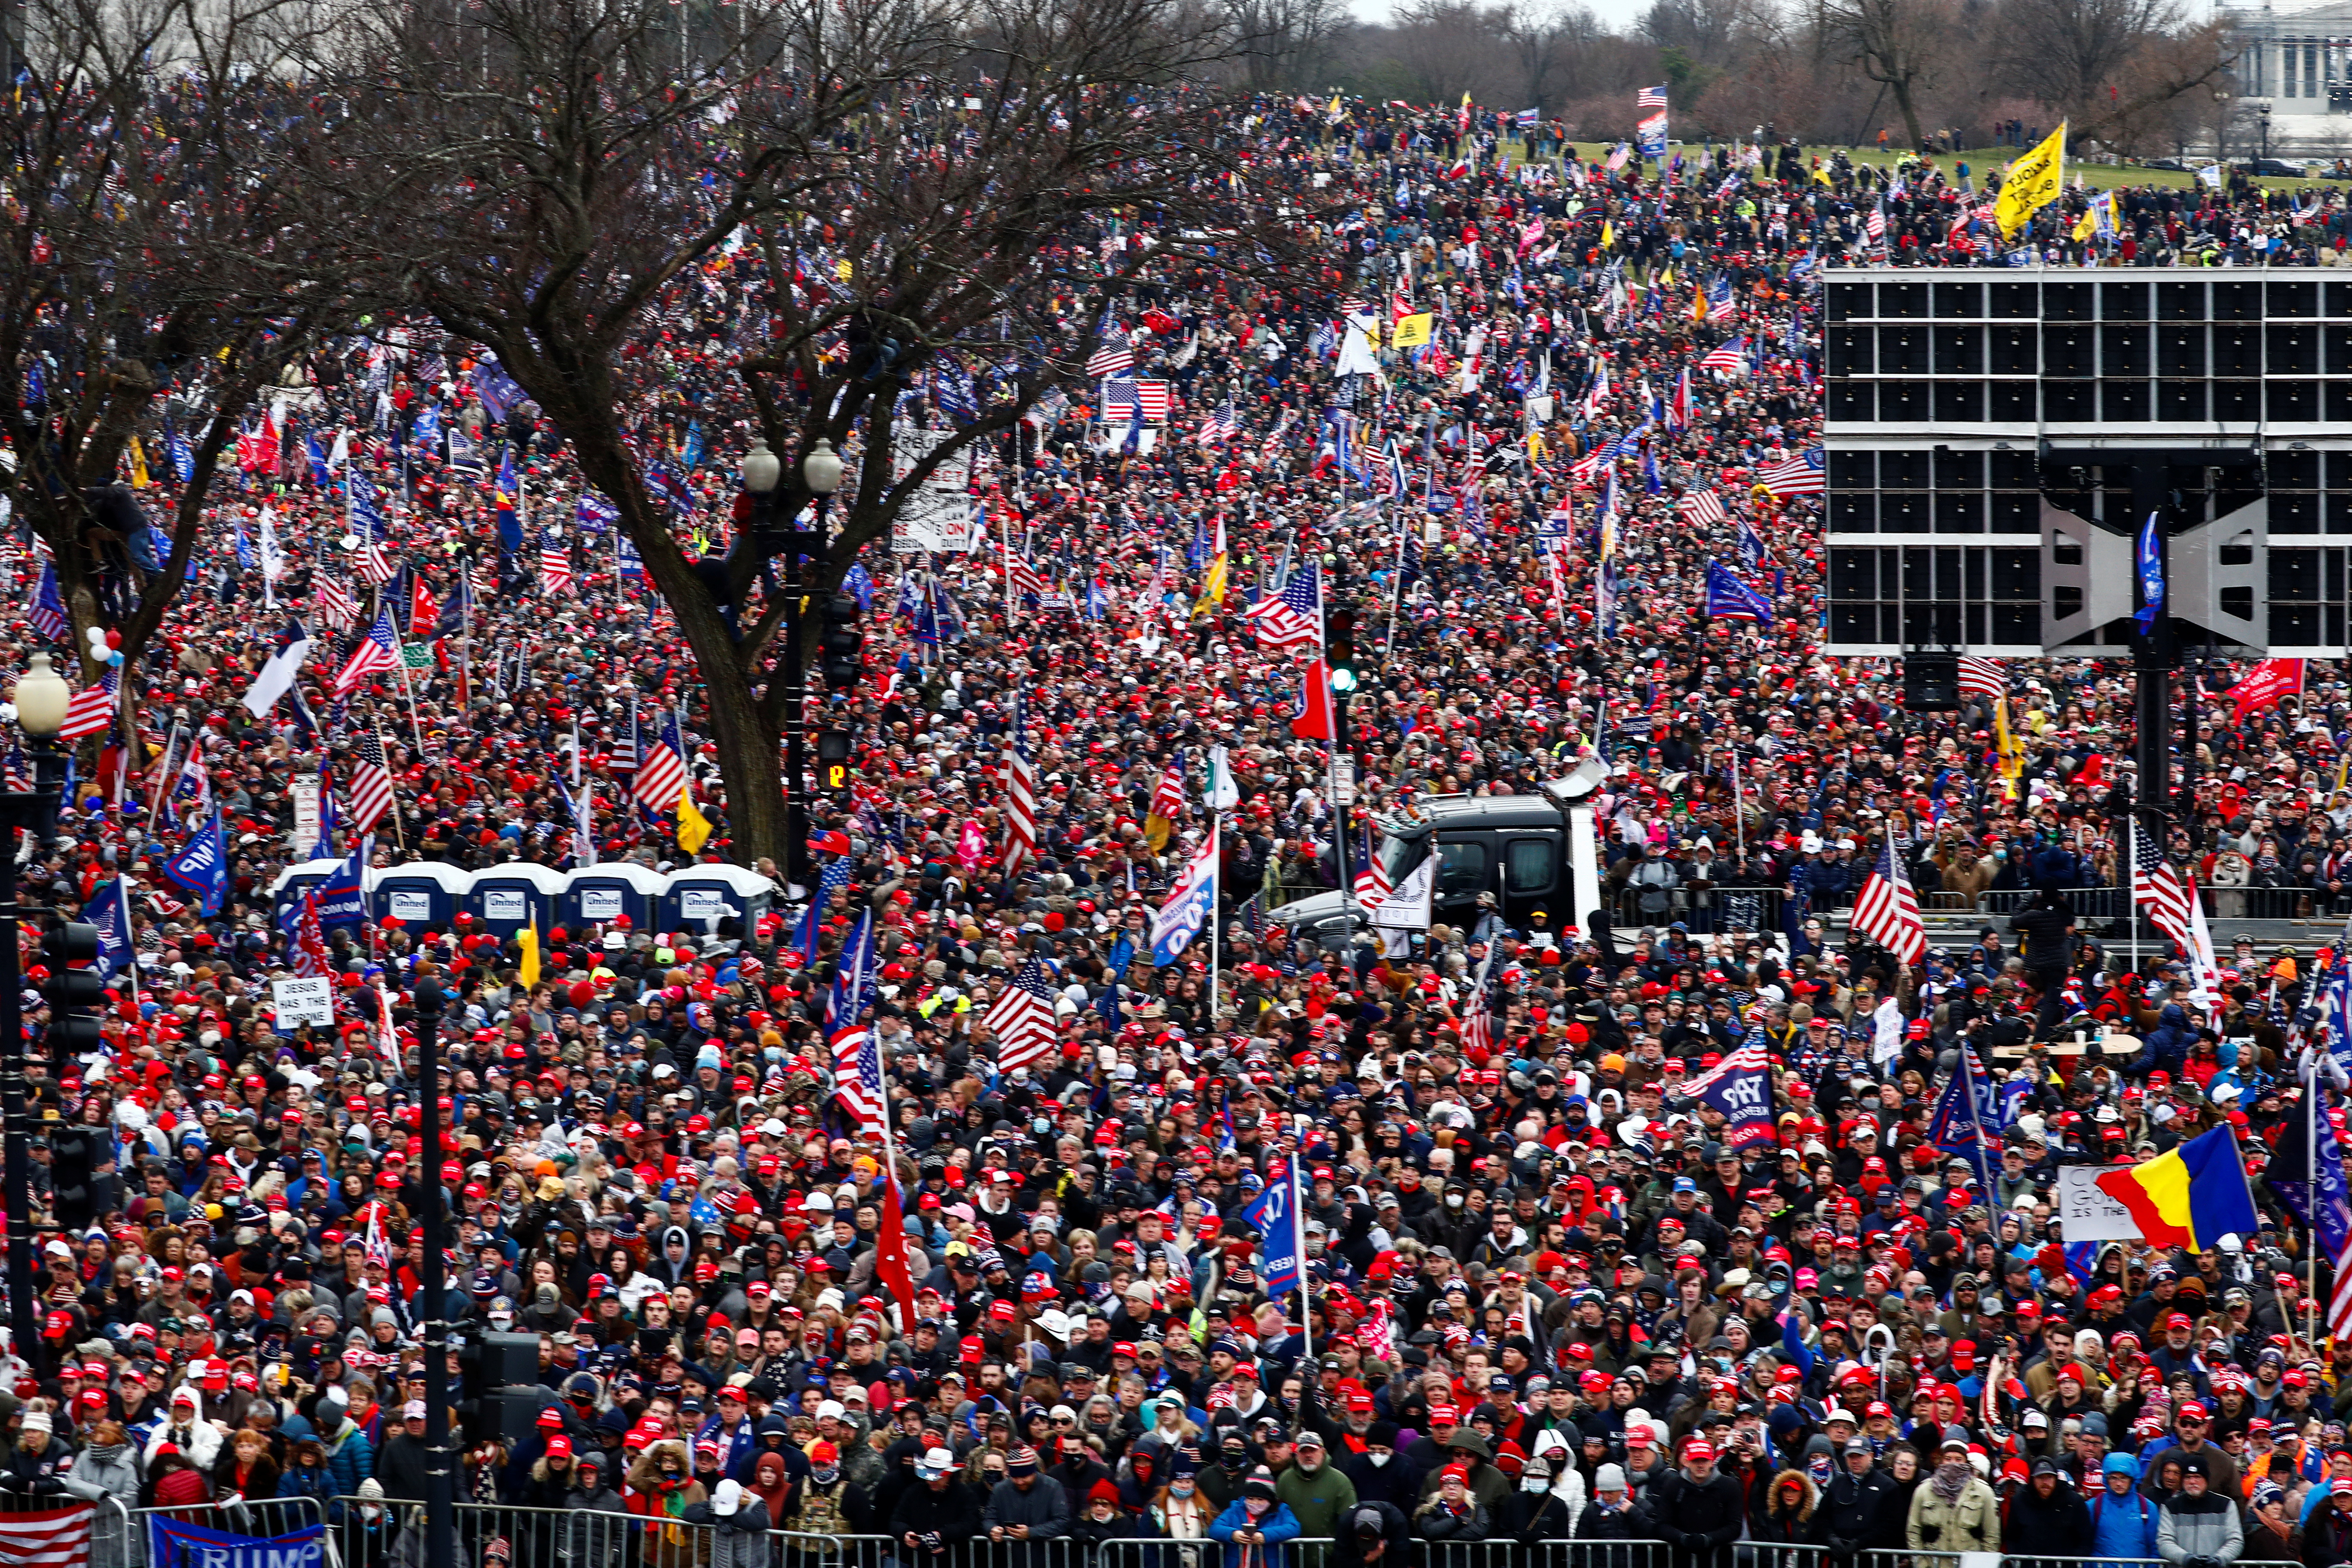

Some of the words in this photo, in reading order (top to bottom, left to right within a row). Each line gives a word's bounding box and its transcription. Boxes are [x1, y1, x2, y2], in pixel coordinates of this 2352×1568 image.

[489, 897, 524, 906] United
[585, 896, 621, 905] United
[284, 982, 318, 994] JESUS
[279, 998, 300, 1009] HAS
[306, 996, 327, 1007] THE
[285, 1012, 325, 1023] THRONE
[2071, 1208, 2092, 1218] IS
[2102, 1207, 2127, 1216] THE
